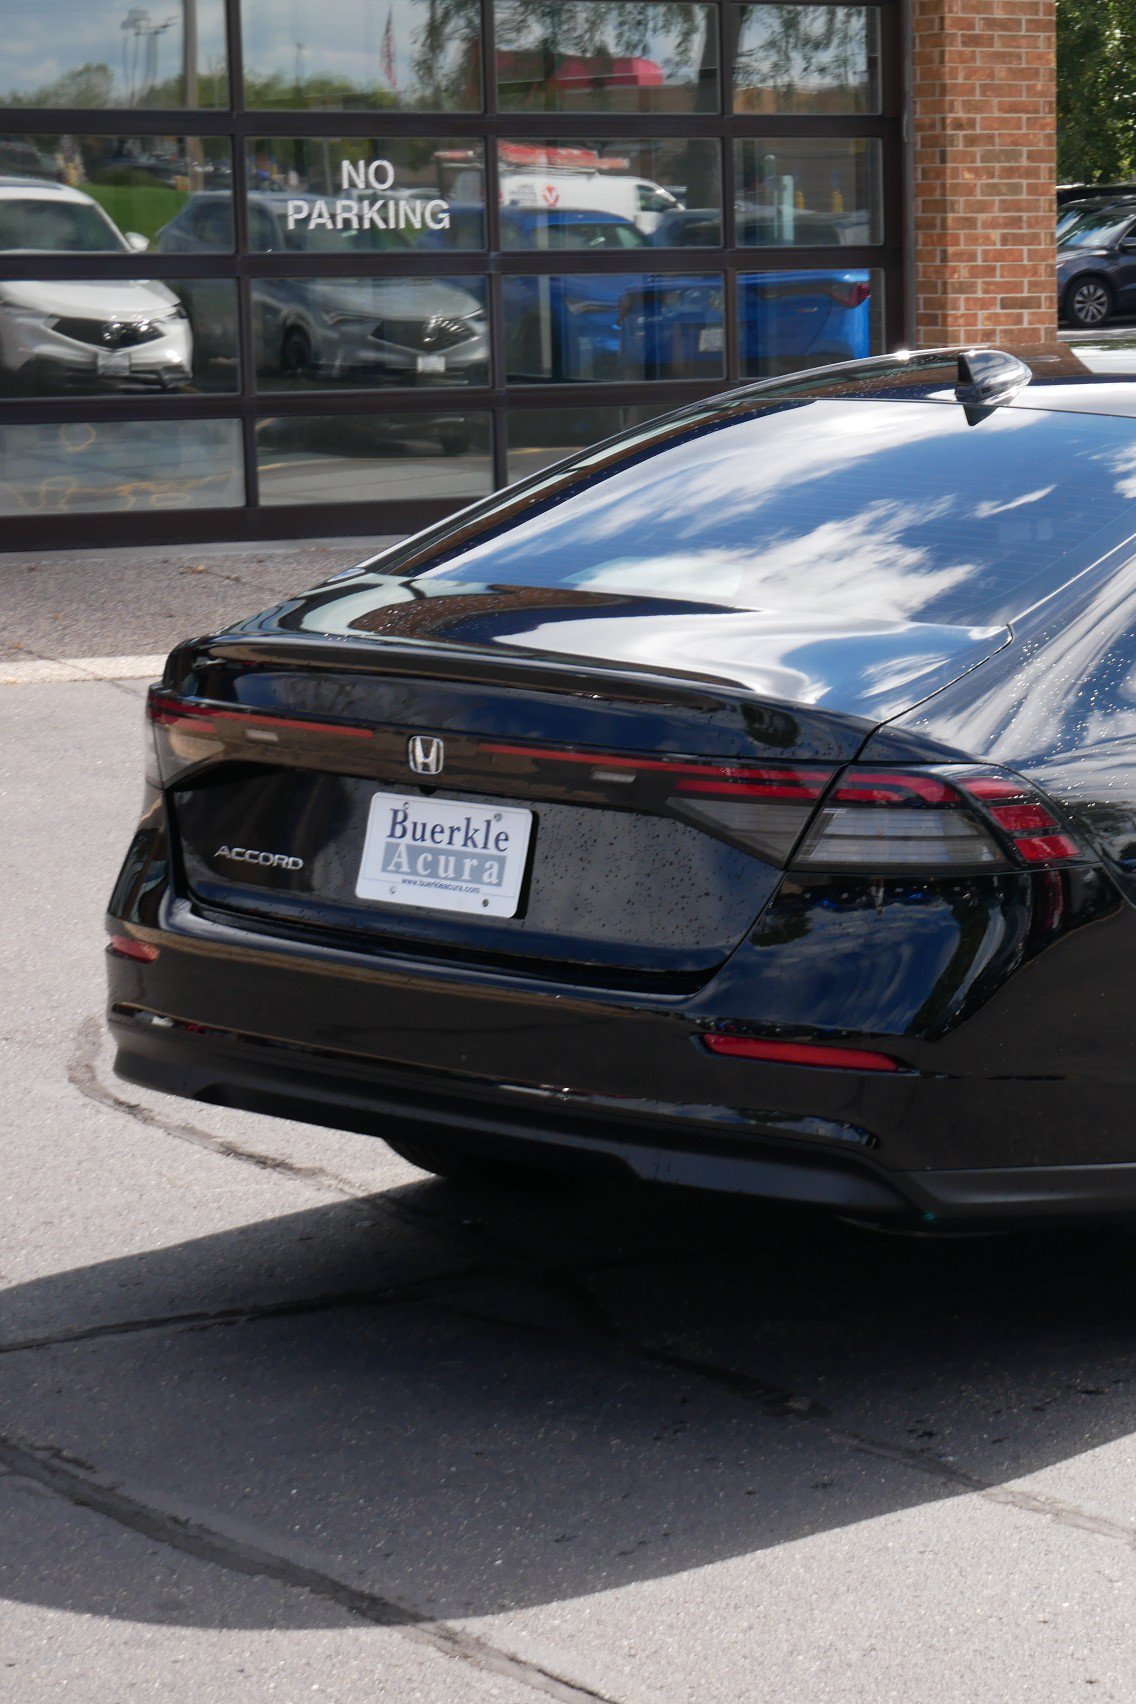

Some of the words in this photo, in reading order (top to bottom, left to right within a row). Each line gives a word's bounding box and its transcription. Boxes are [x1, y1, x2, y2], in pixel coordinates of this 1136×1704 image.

[341, 159, 395, 190] NO
[287, 199, 451, 230] PARKING
[386, 808, 510, 852] Buerkle
[213, 845, 304, 871] ACCORD
[386, 842, 501, 885] Acura
